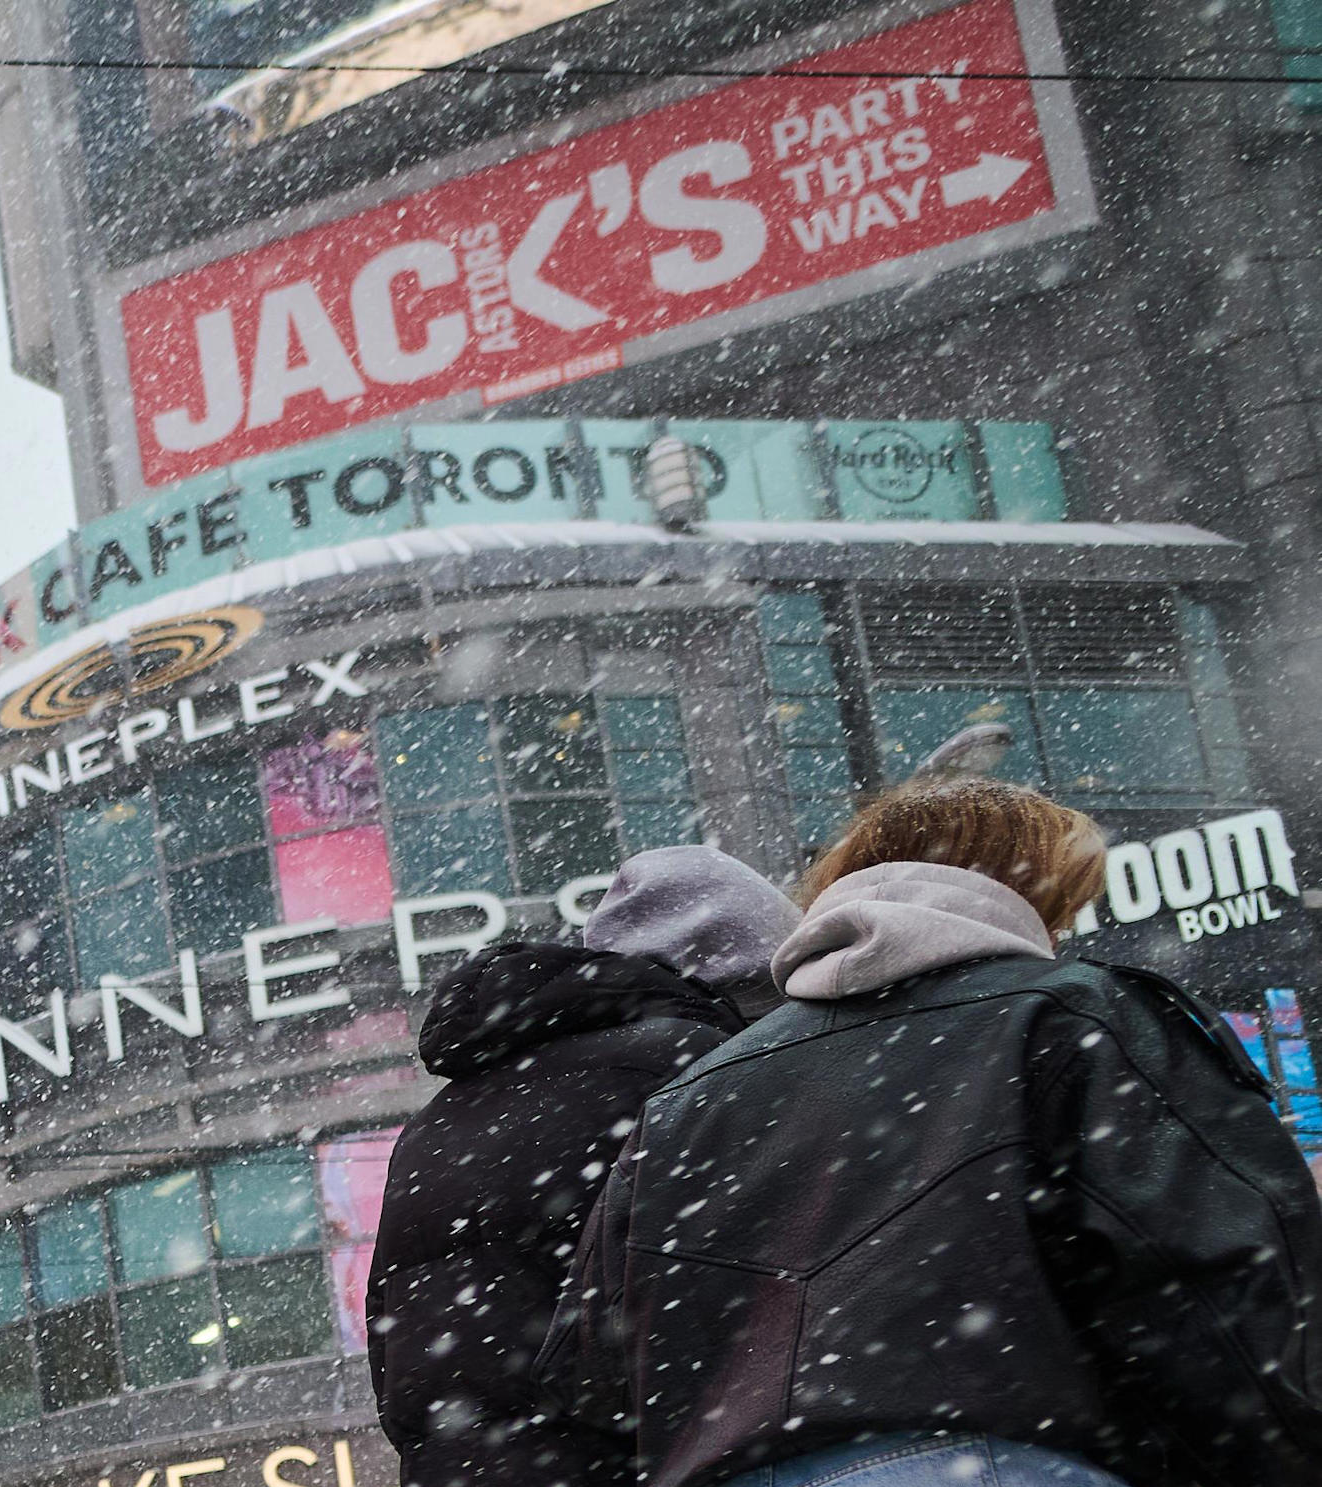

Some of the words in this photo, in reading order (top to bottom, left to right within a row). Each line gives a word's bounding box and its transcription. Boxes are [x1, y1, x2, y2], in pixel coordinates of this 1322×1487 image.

[771, 60, 969, 161] PARTY
[780, 129, 932, 206] THIS
[790, 176, 927, 254] WAY
[39, 485, 245, 626] CAFE
[1176, 890, 1282, 944] BOWL
